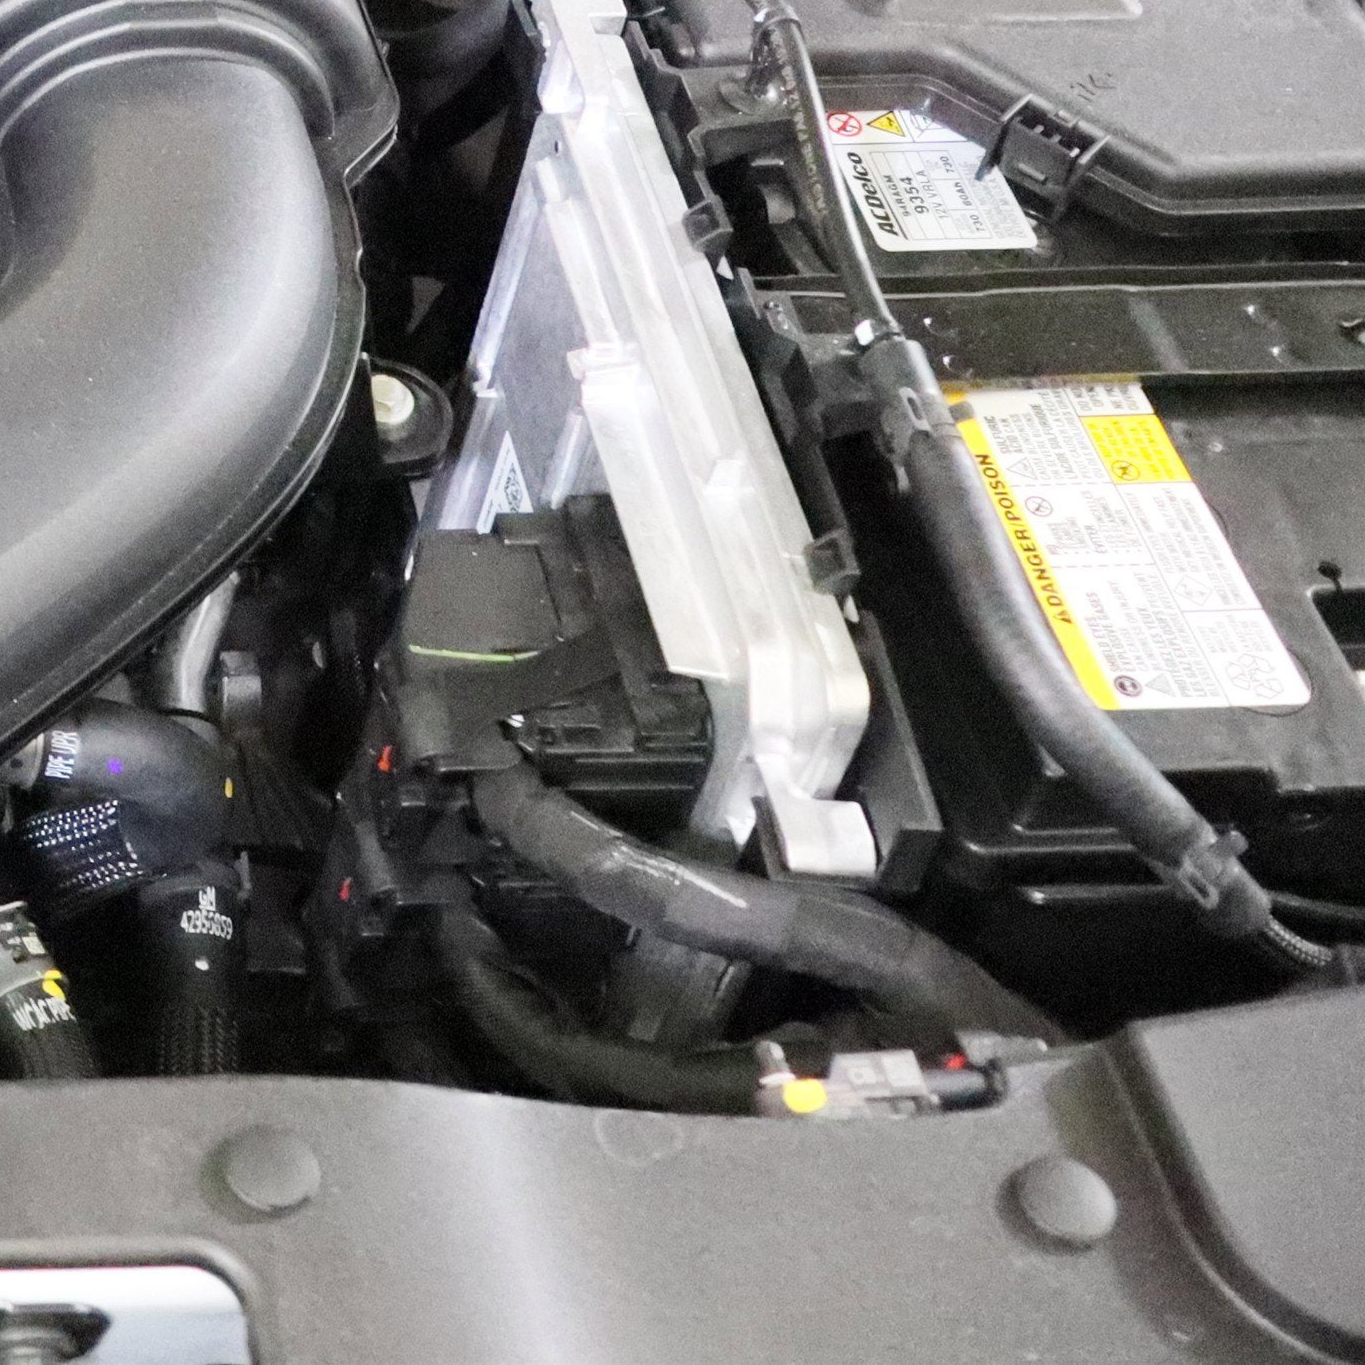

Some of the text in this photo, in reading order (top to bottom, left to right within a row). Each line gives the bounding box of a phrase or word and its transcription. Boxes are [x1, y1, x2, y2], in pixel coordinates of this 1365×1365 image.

[847, 152, 899, 236] ACDelco
[901, 176, 930, 214] 9354
[969, 213, 986, 233] 730
